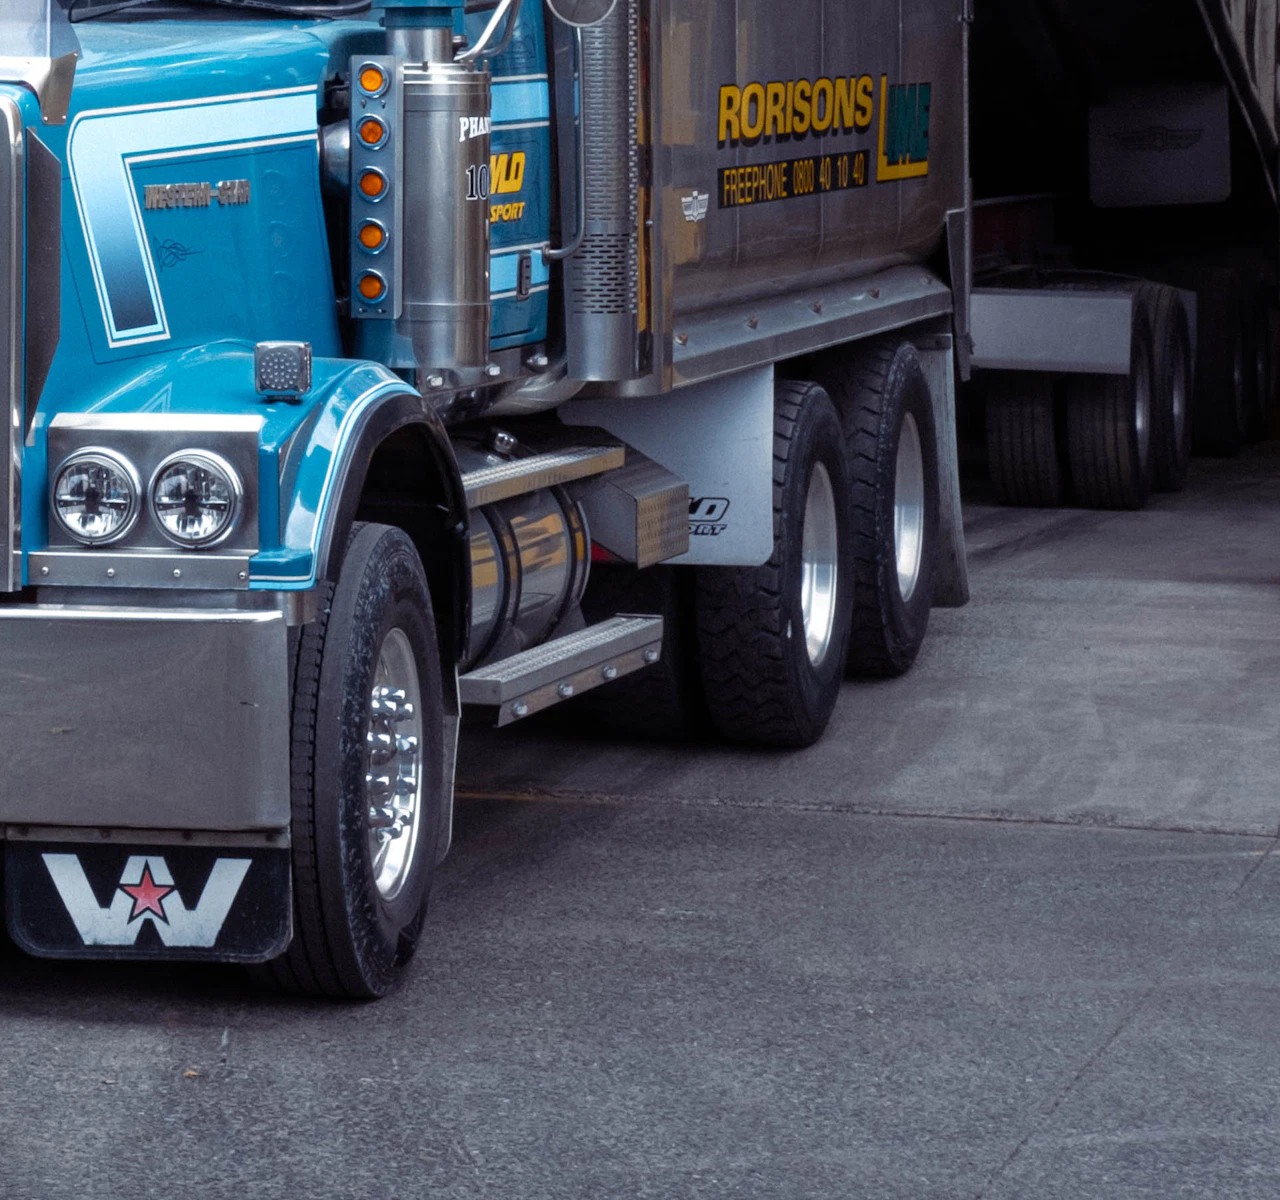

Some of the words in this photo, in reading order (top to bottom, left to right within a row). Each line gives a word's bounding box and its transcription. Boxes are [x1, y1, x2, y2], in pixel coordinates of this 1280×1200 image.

[717, 74, 874, 146] RORISONS
[723, 162, 788, 206] FREEPHONE
[793, 158, 815, 195] 0800
[819, 156, 832, 191] 40
[837, 154, 849, 188] 10
[853, 152, 865, 185] 40
